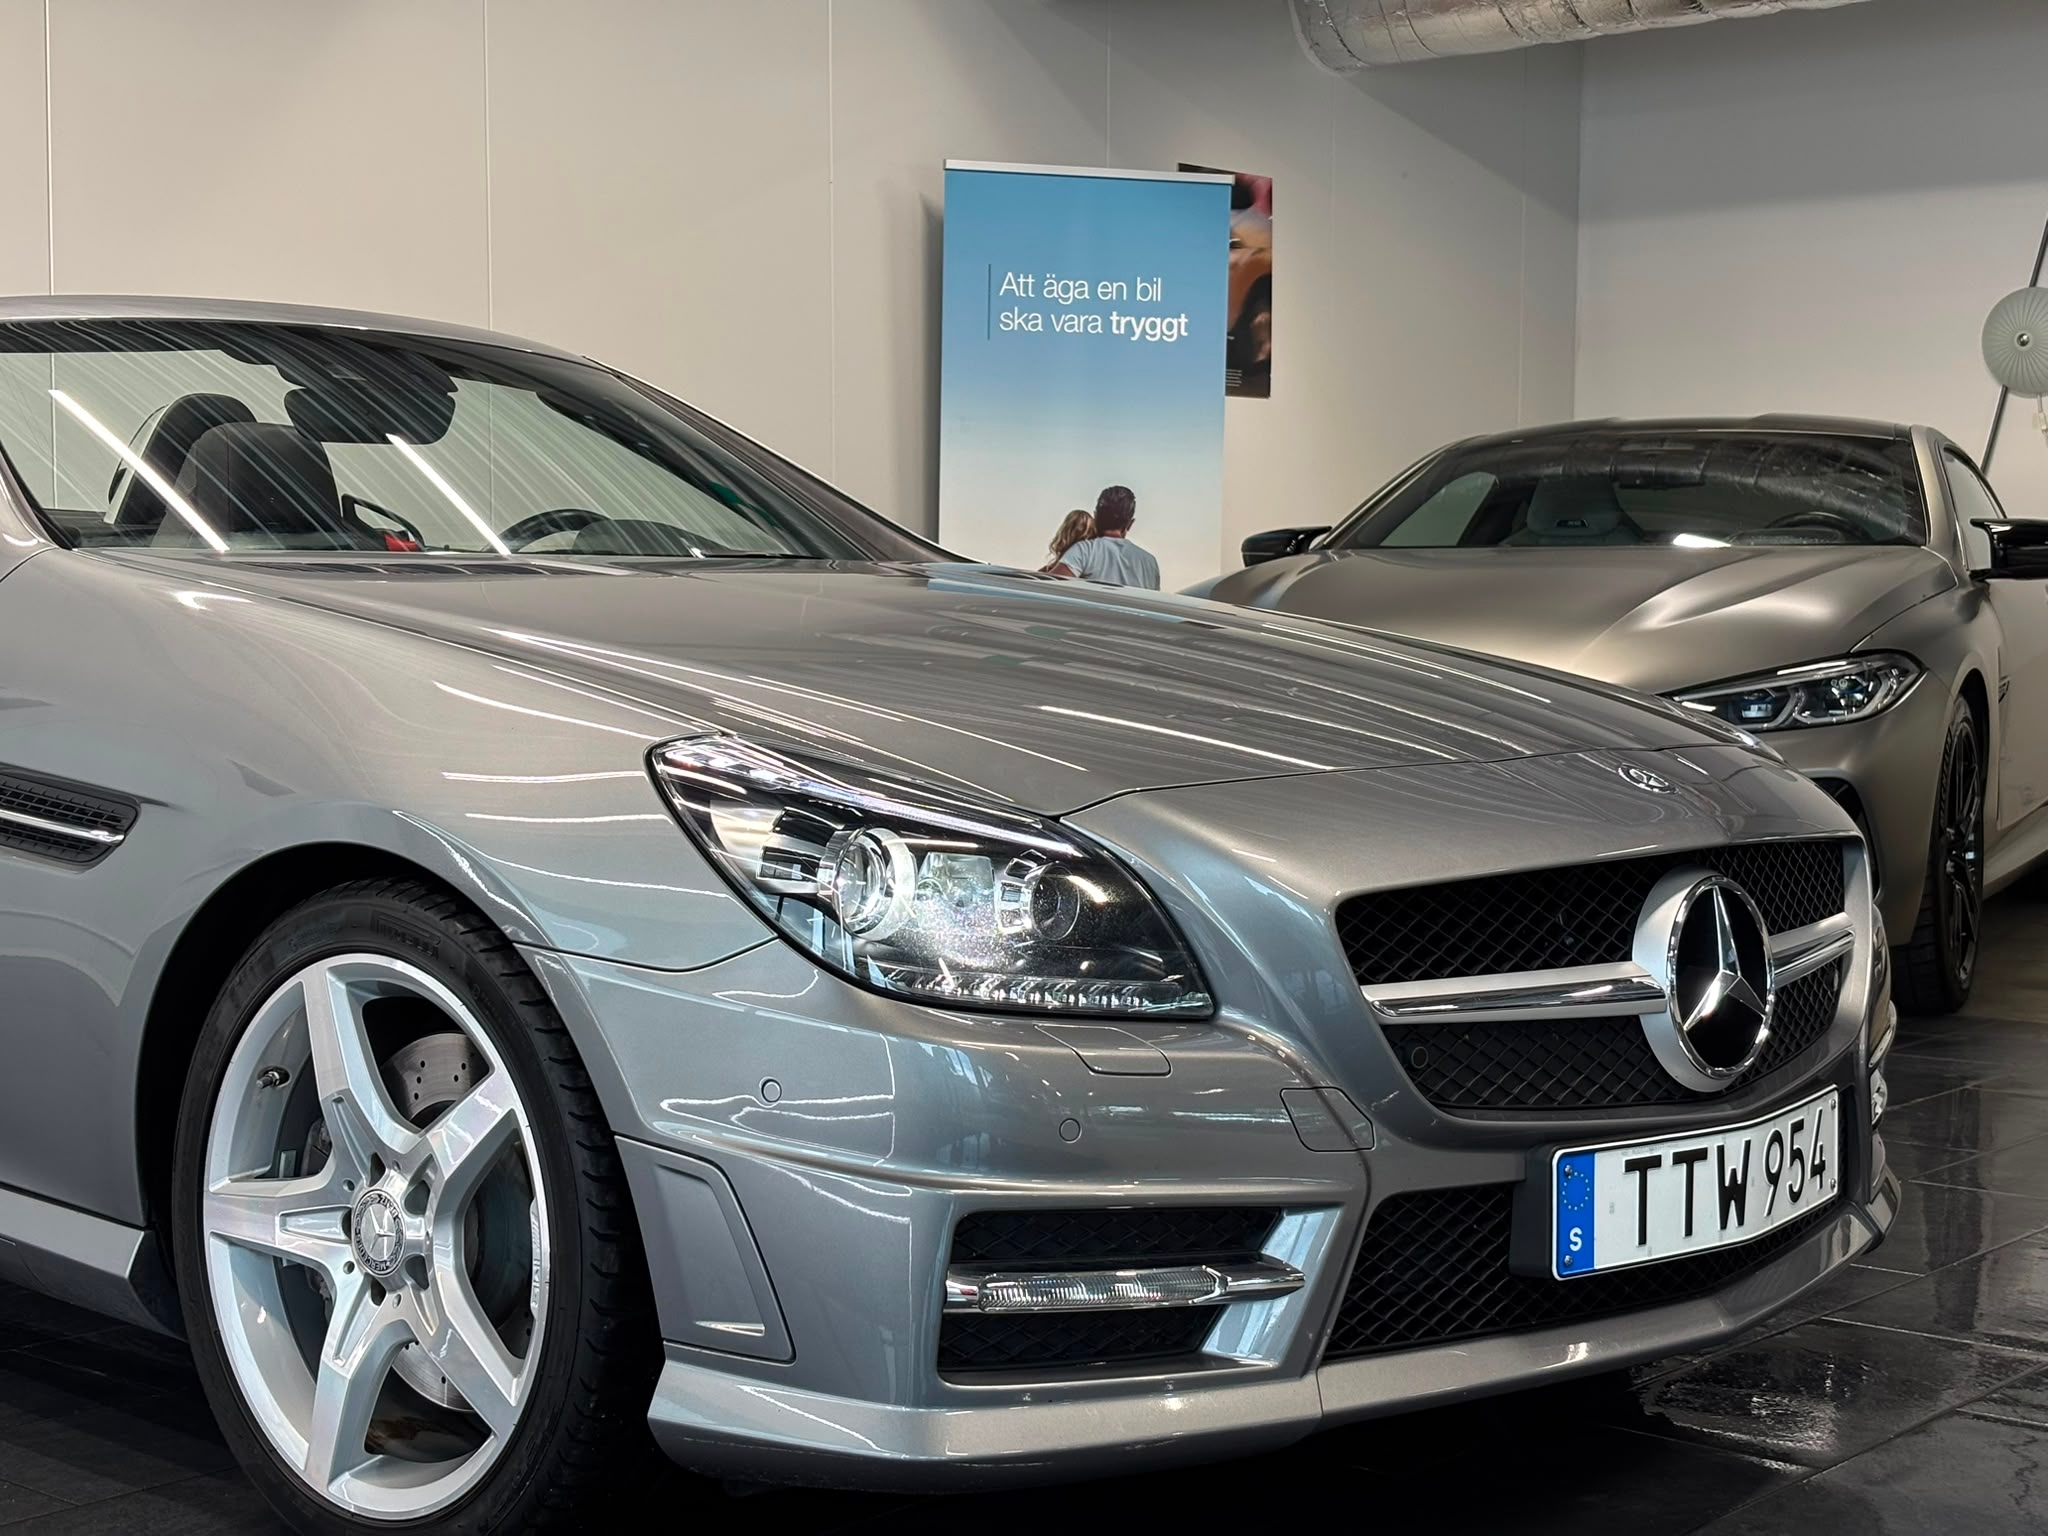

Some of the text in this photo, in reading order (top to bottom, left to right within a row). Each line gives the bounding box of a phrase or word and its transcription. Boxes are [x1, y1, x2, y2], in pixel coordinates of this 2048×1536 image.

[999, 272, 1161, 305] Att äga en bil
[999, 307, 1188, 342] ska vara tryggt
[1623, 1107, 1826, 1247] TTW 954
[1569, 1227, 1583, 1252] S
